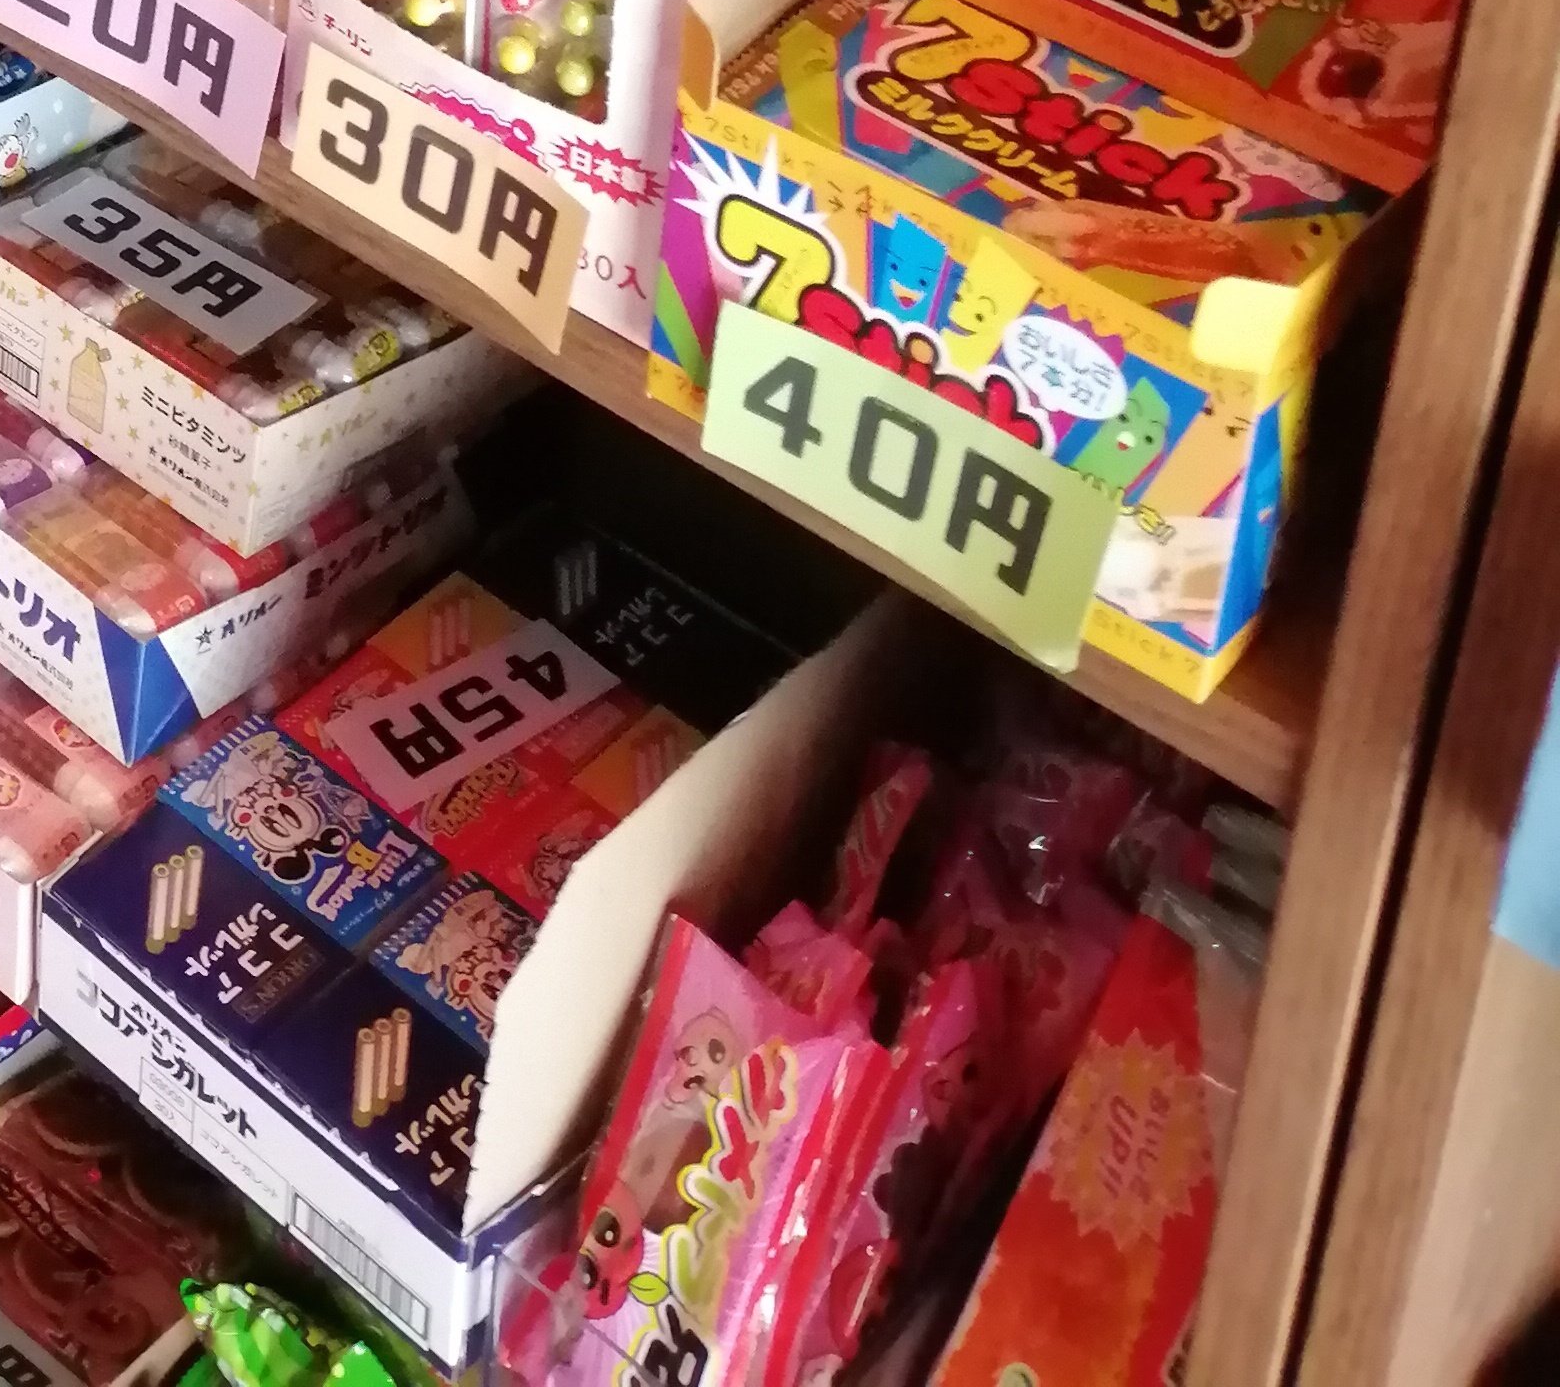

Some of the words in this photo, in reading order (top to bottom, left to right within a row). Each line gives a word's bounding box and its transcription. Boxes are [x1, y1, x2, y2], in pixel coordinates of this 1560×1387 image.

[323, 13, 373, 56] チーリン
[319, 77, 558, 297] 30円
[866, 79, 1081, 200] ミルククリーム
[945, 58, 1240, 222] Stick
[64, 196, 262, 319] 35円
[140, 385, 247, 464] ミニビタミンツ
[745, 355, 1051, 595] 40円
[220, 592, 283, 640] オリオン
[369, 649, 570, 781] 45円
[183, 901, 278, 977] シガレット
[217, 922, 305, 1005] ココア
[77, 967, 149, 1037] ココア
[130, 1000, 187, 1054] オリオン
[151, 1033, 258, 1140] シガレット
